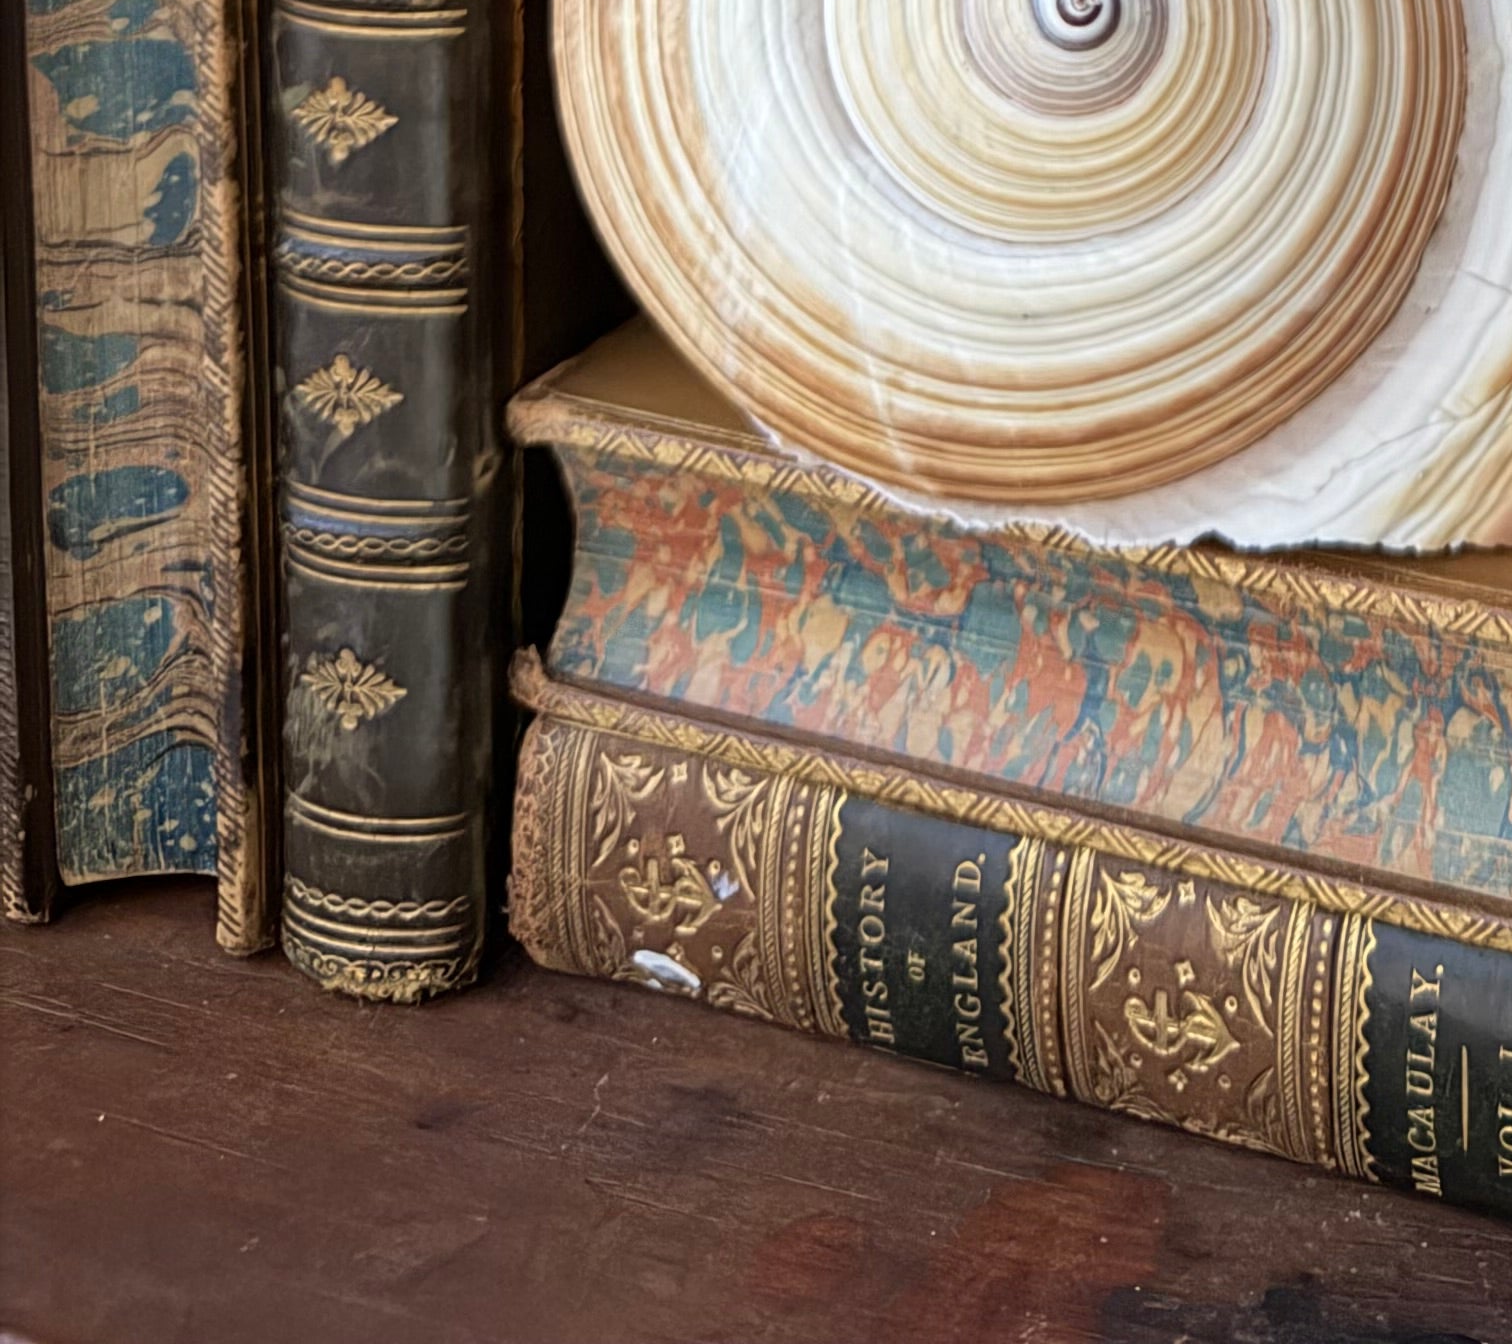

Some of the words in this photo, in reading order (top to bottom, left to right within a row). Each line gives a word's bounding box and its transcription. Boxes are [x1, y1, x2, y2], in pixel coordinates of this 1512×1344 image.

[858, 847, 896, 1045] HISTORY
[907, 949, 926, 982] OF
[951, 852, 989, 1068] ENGLAND.
[1405, 964, 1445, 1198] MACAULAY.
